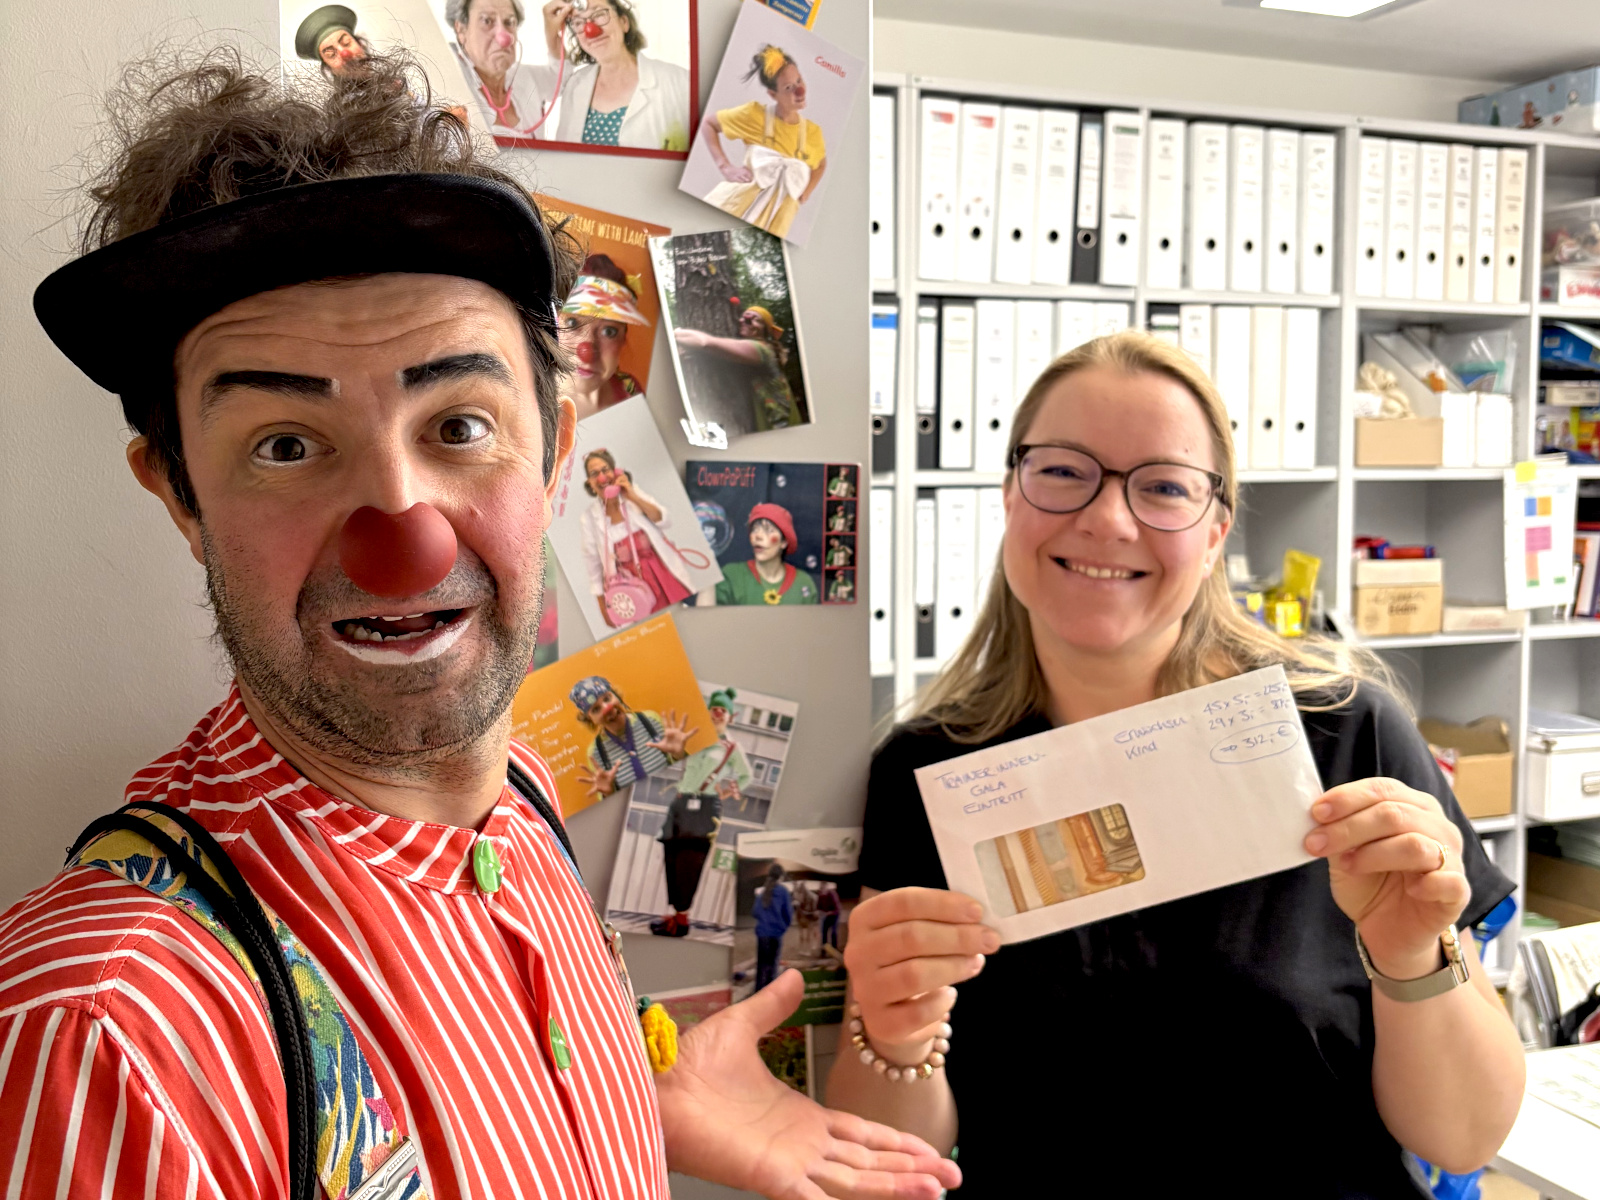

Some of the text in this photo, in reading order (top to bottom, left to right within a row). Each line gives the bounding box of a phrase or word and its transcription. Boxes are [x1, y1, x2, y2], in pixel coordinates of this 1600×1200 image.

[598, 222, 622, 242] WITH
[970, 780, 1008, 797] GALA
[963, 787, 1028, 814] EINTRITT
